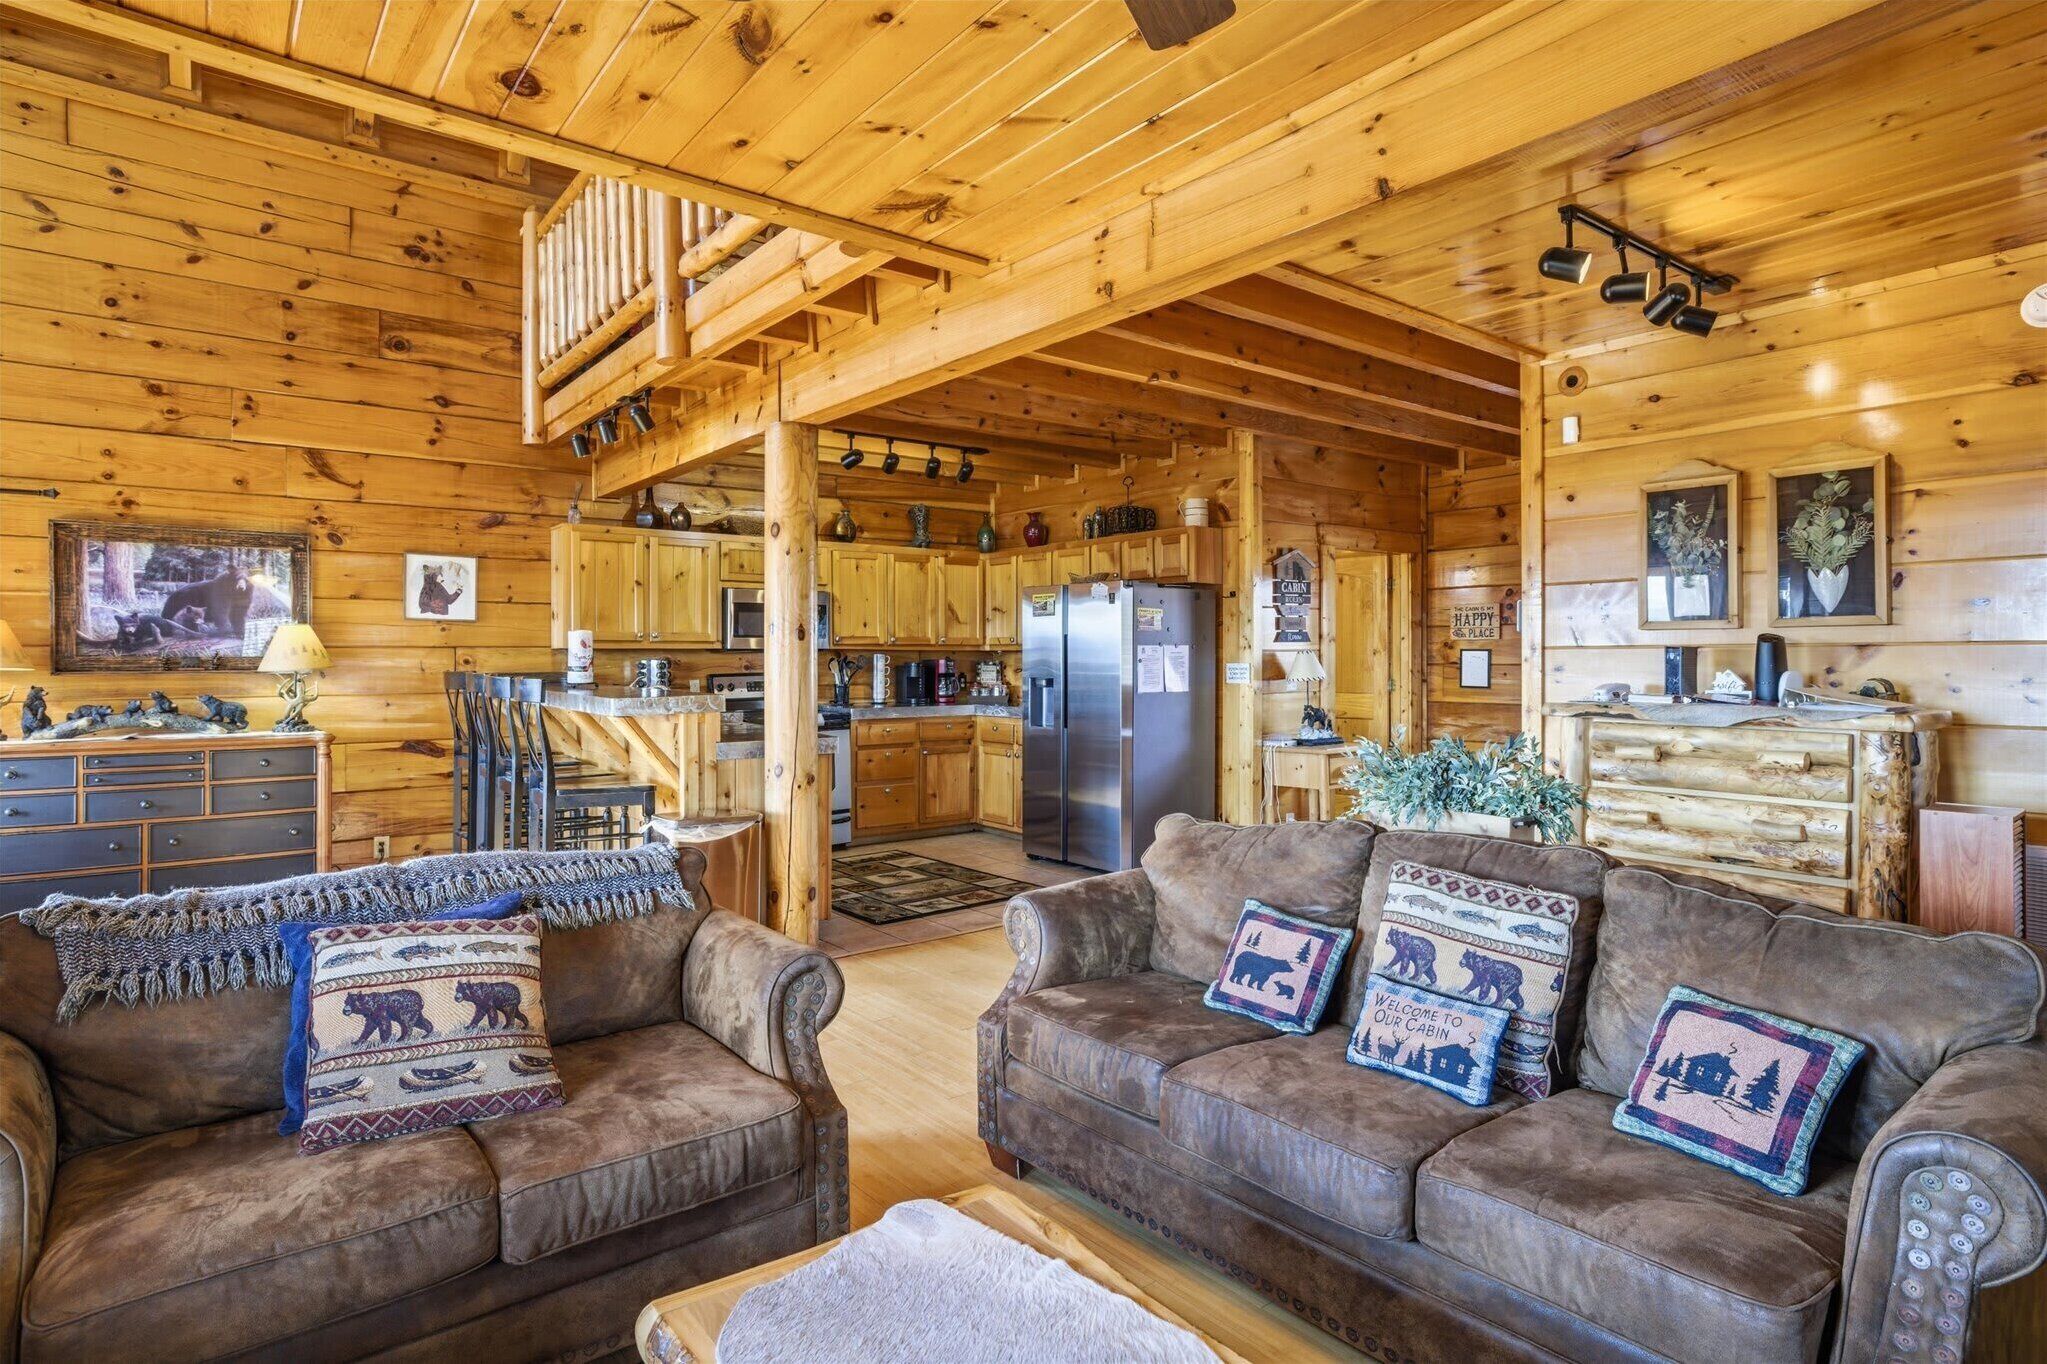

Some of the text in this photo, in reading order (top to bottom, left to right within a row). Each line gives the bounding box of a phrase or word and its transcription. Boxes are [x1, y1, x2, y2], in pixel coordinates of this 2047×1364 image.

[1281, 582, 1307, 593] CABIN
[1454, 612, 1494, 627] HAPPY
[1468, 628, 1494, 638] PLACE
[1374, 993, 1463, 1028] WELCOME TO
[1374, 1009, 1450, 1040] OUR CABIN
